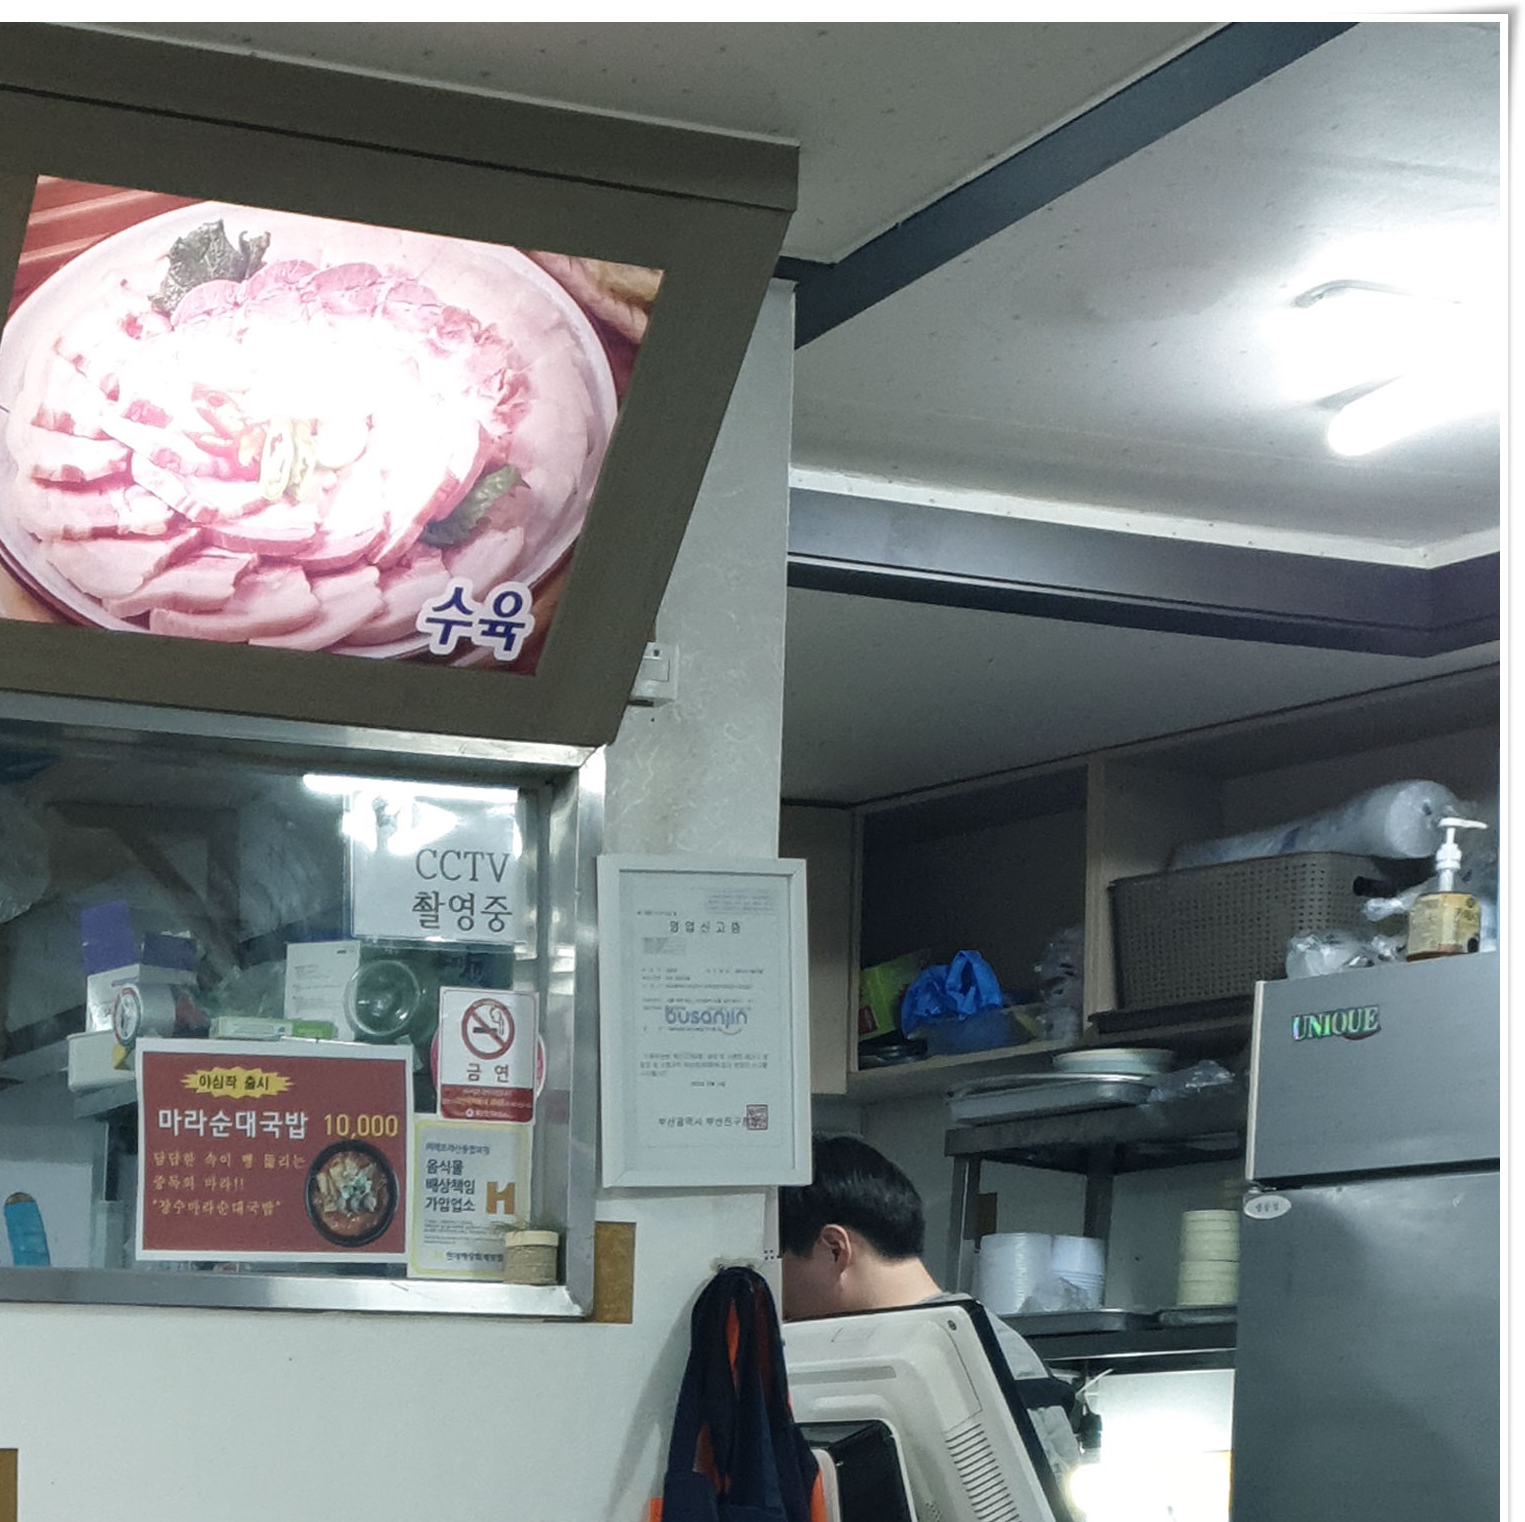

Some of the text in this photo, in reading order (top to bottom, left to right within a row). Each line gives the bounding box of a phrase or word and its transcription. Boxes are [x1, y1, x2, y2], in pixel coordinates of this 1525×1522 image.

[424, 586, 528, 657] 수육
[414, 847, 510, 884] CCTV
[412, 890, 513, 933] 촬영중
[1292, 1005, 1380, 1041] UNIQUE
[198, 1073, 270, 1091] 야심작 출시
[157, 1108, 399, 1140] 마라순대국밥 10,000
[204, 1151, 232, 1168] 속이
[426, 1158, 465, 1175] 음식물
[425, 1177, 476, 1195] 배상책임
[425, 1196, 477, 1213] 가입업소
